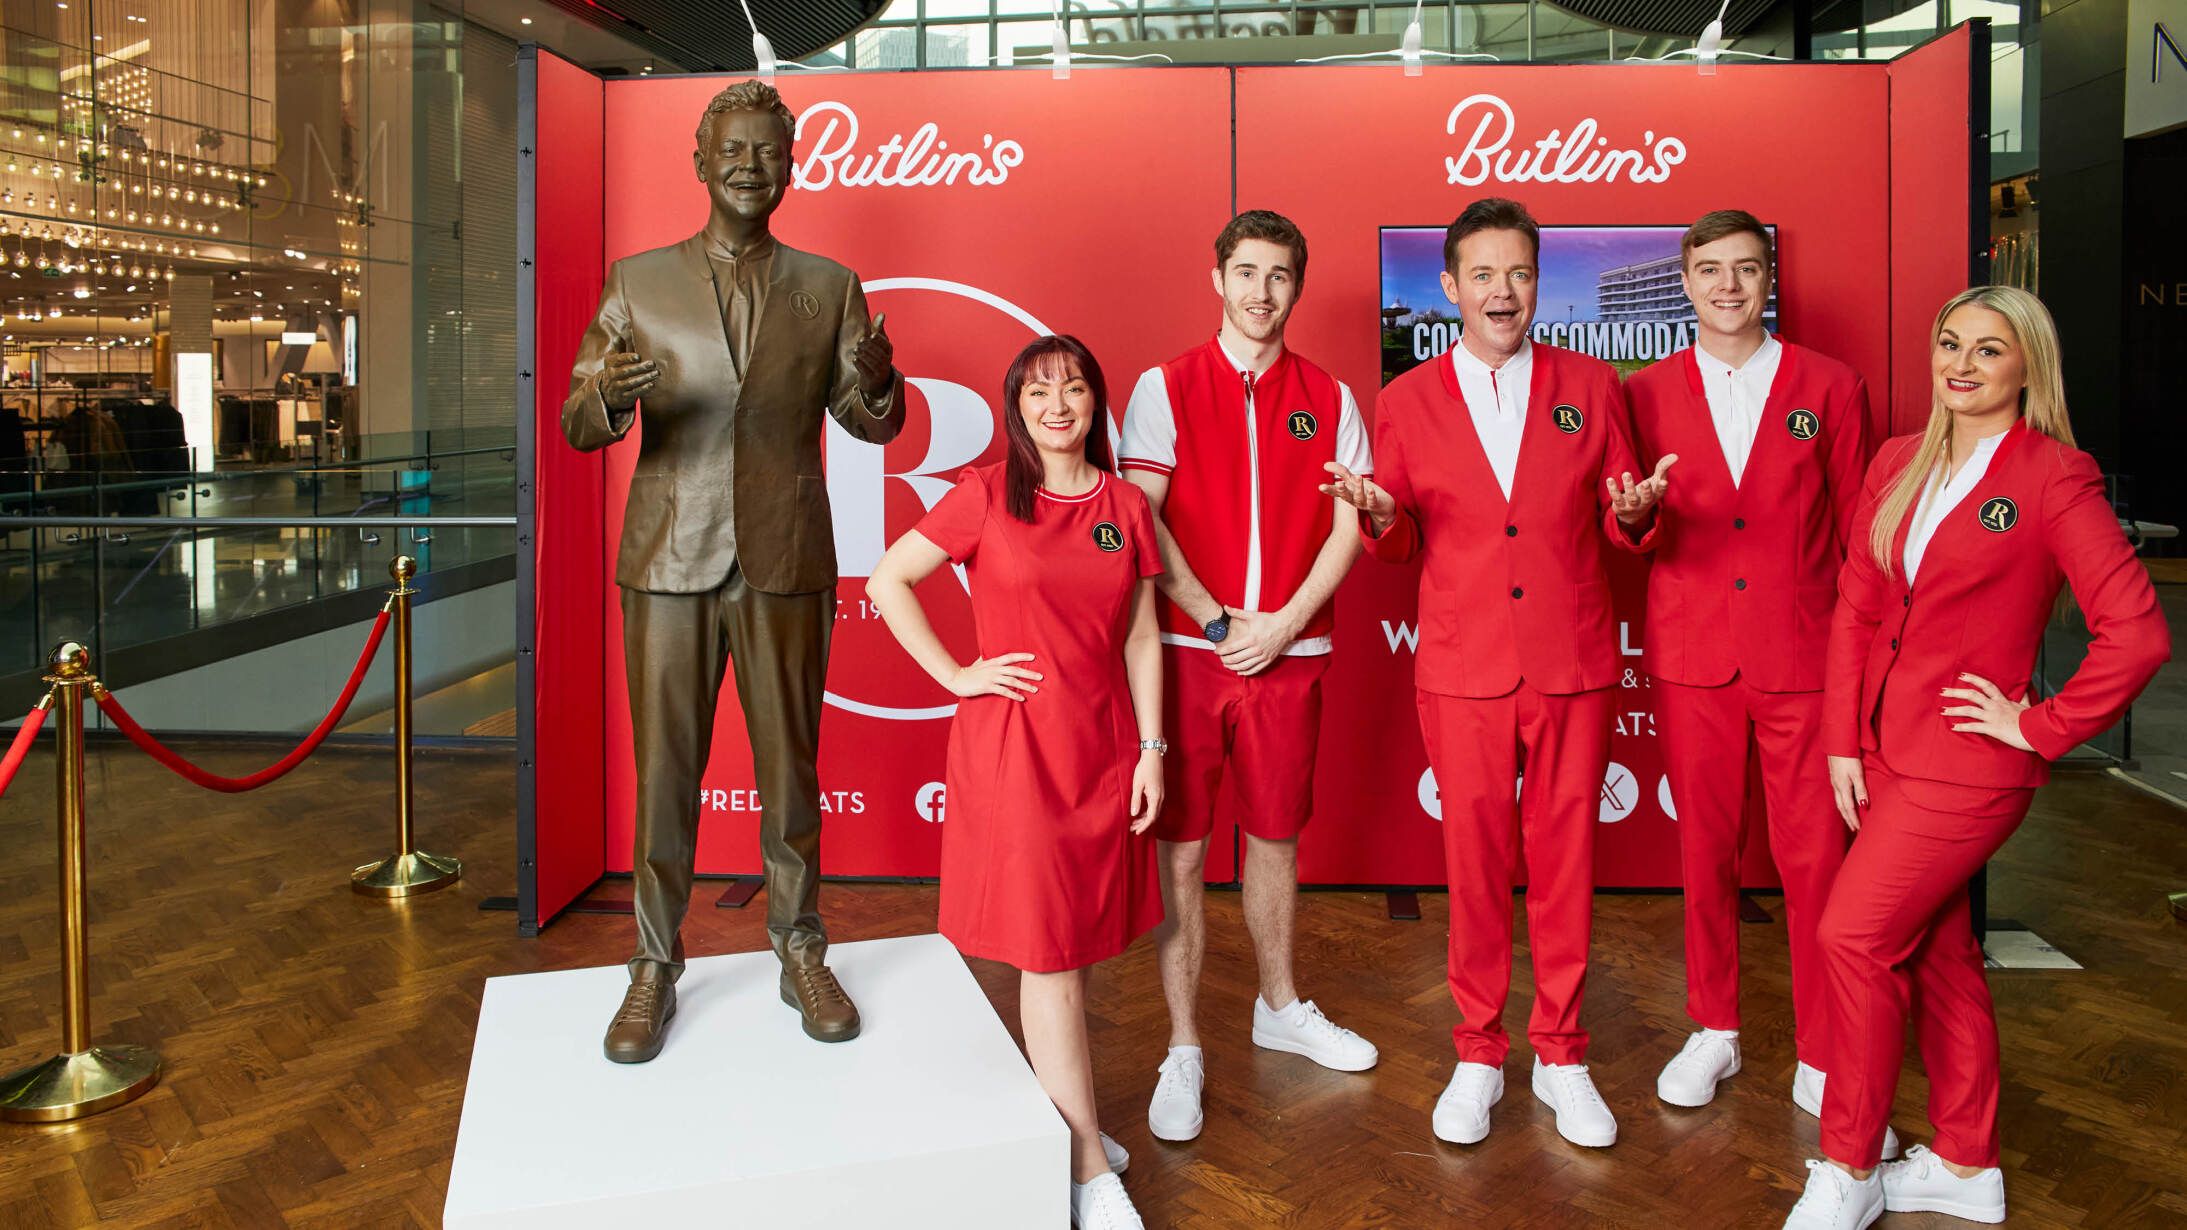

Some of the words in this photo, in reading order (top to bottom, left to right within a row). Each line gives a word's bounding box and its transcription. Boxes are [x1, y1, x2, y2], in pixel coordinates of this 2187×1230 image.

[792, 101, 1024, 191] Butlin's
[1445, 94, 1687, 186] Butlin's
[1294, 416, 1313, 435] R
[1558, 410, 1578, 429] R
[1795, 413, 1812, 437] R
[1986, 502, 2009, 530] R
[1099, 527, 1119, 547] R
